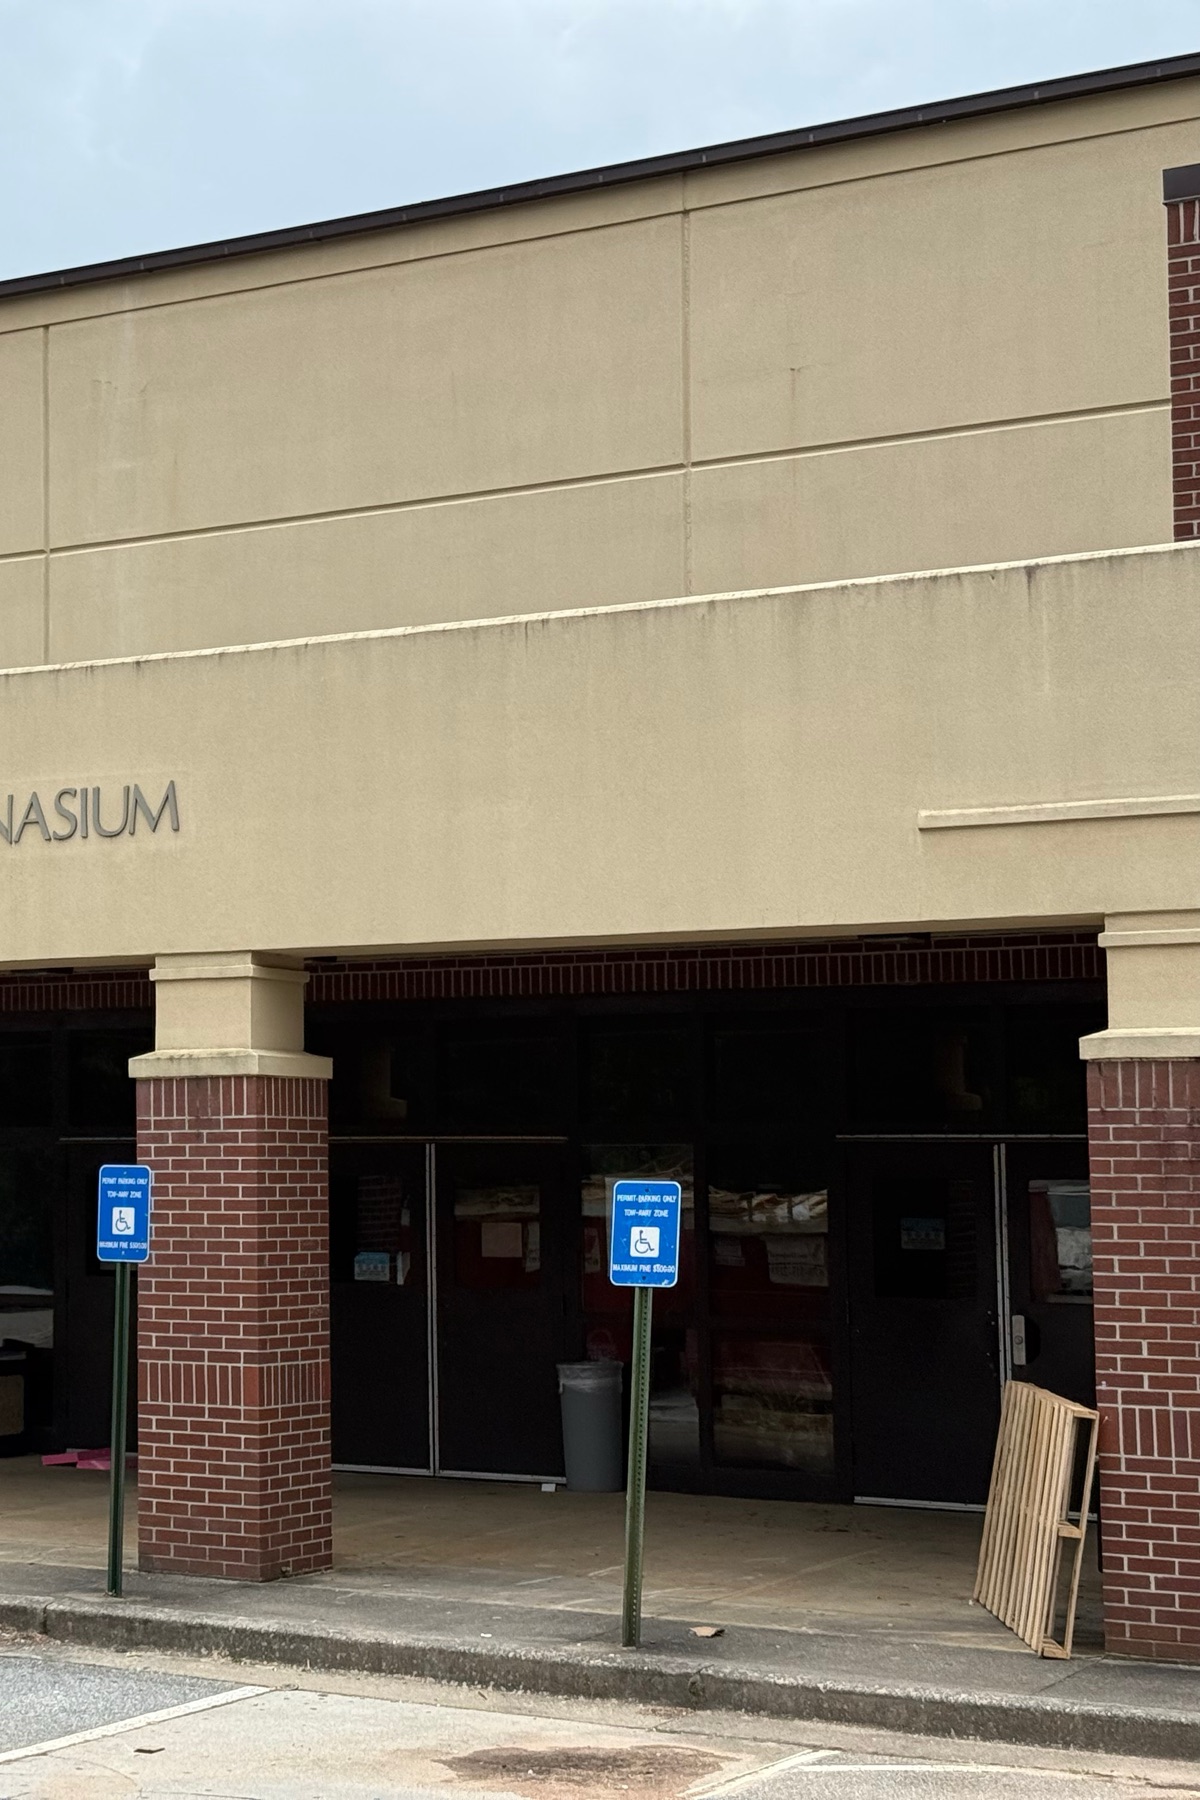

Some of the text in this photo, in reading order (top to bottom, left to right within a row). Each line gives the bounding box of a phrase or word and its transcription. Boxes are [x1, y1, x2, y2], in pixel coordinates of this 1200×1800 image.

[102, 1177, 117, 1185] PERMIT
[118, 1177, 136, 1185] PARKING
[107, 1190, 142, 1199] TOW-AWAY ZONE
[616, 1194, 677, 1203] PERMIT PARKING ONLY
[624, 1209, 669, 1217] TOW-AWAY ZONE
[99, 1241, 118, 1249] MAXIMUM
[119, 1241, 129, 1249] FINE
[612, 1263, 638, 1271] MAXIMUM
[639, 1264, 651, 1272] FINE
